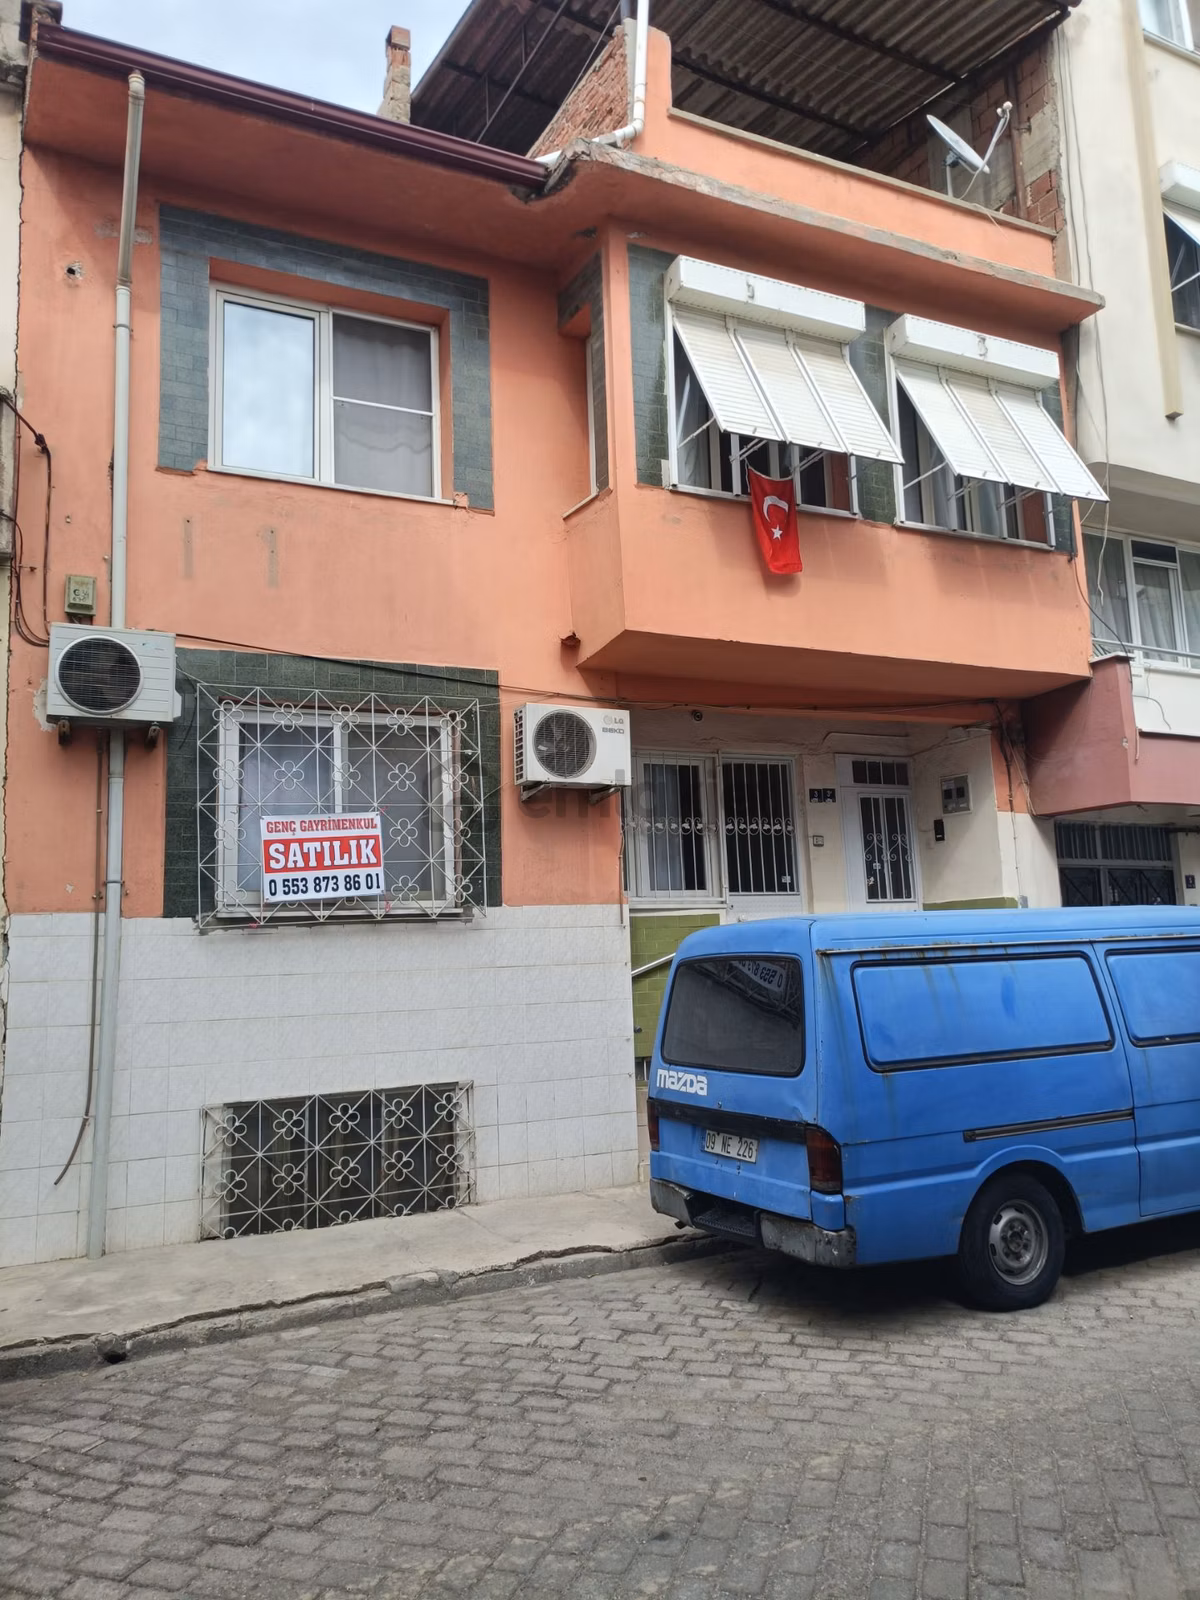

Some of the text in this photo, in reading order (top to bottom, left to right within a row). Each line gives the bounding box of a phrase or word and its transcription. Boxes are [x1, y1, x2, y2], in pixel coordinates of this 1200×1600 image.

[266, 816, 378, 836] GENÇ GAYRİMENKUL
[269, 839, 378, 870] SATILIK
[269, 873, 381, 897] 0 553 873 86 01
[705, 1132, 754, 1159] 09 NE 226
